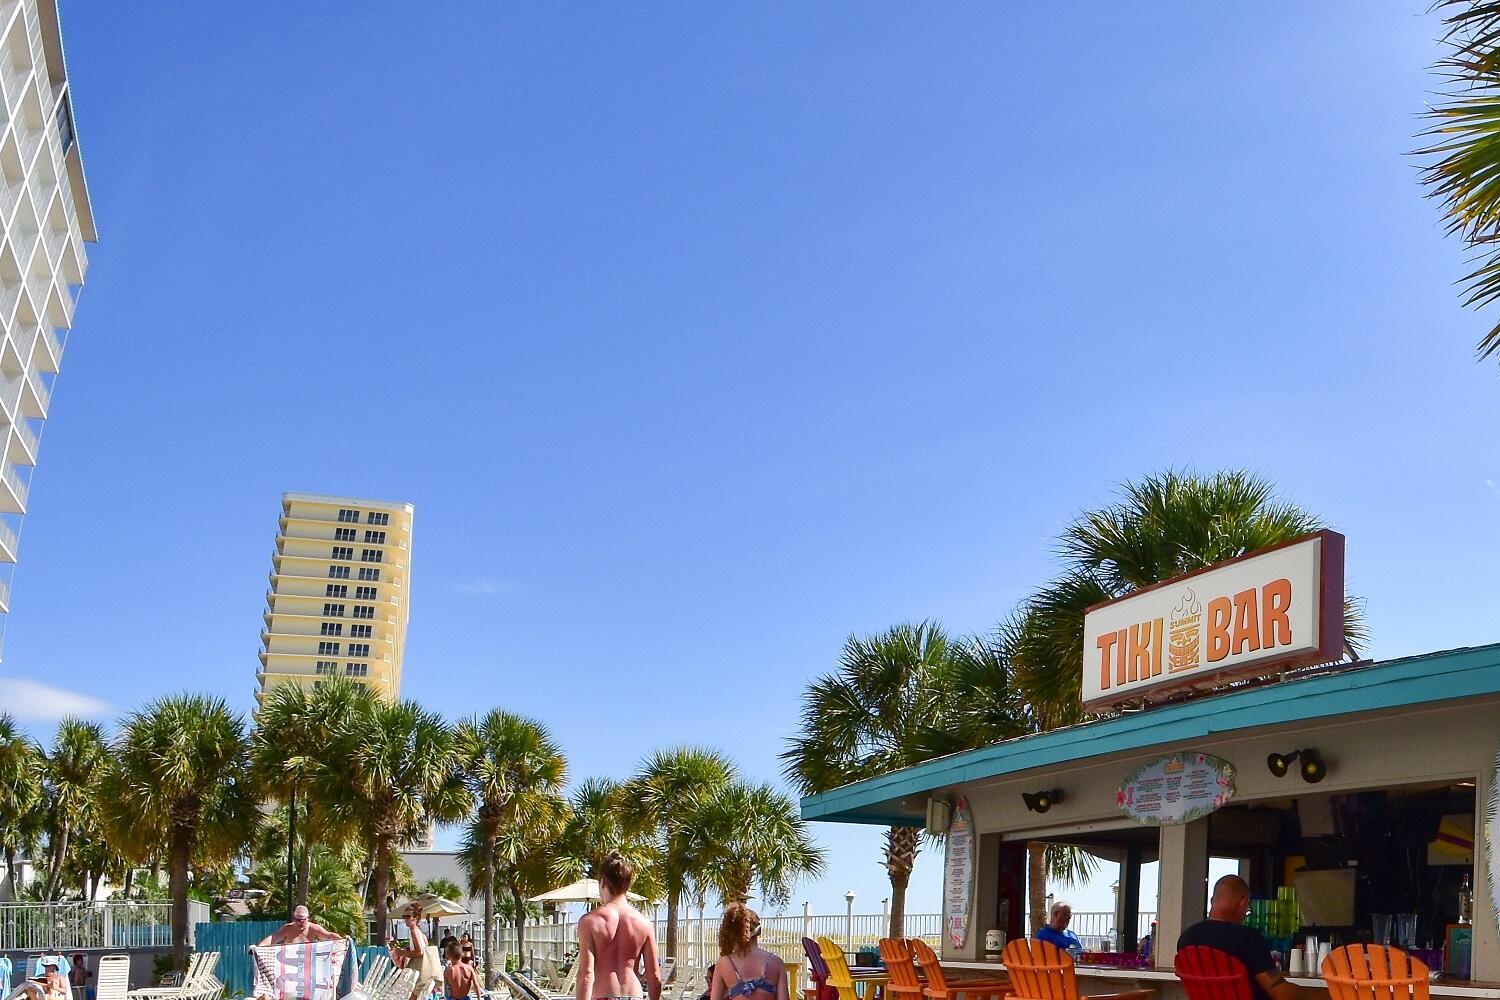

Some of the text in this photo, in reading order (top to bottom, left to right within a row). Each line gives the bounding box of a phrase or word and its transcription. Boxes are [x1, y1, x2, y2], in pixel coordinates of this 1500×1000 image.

[1097, 579, 1292, 691] TIKI BAR
[1170, 614, 1202, 630] SUMMIT
